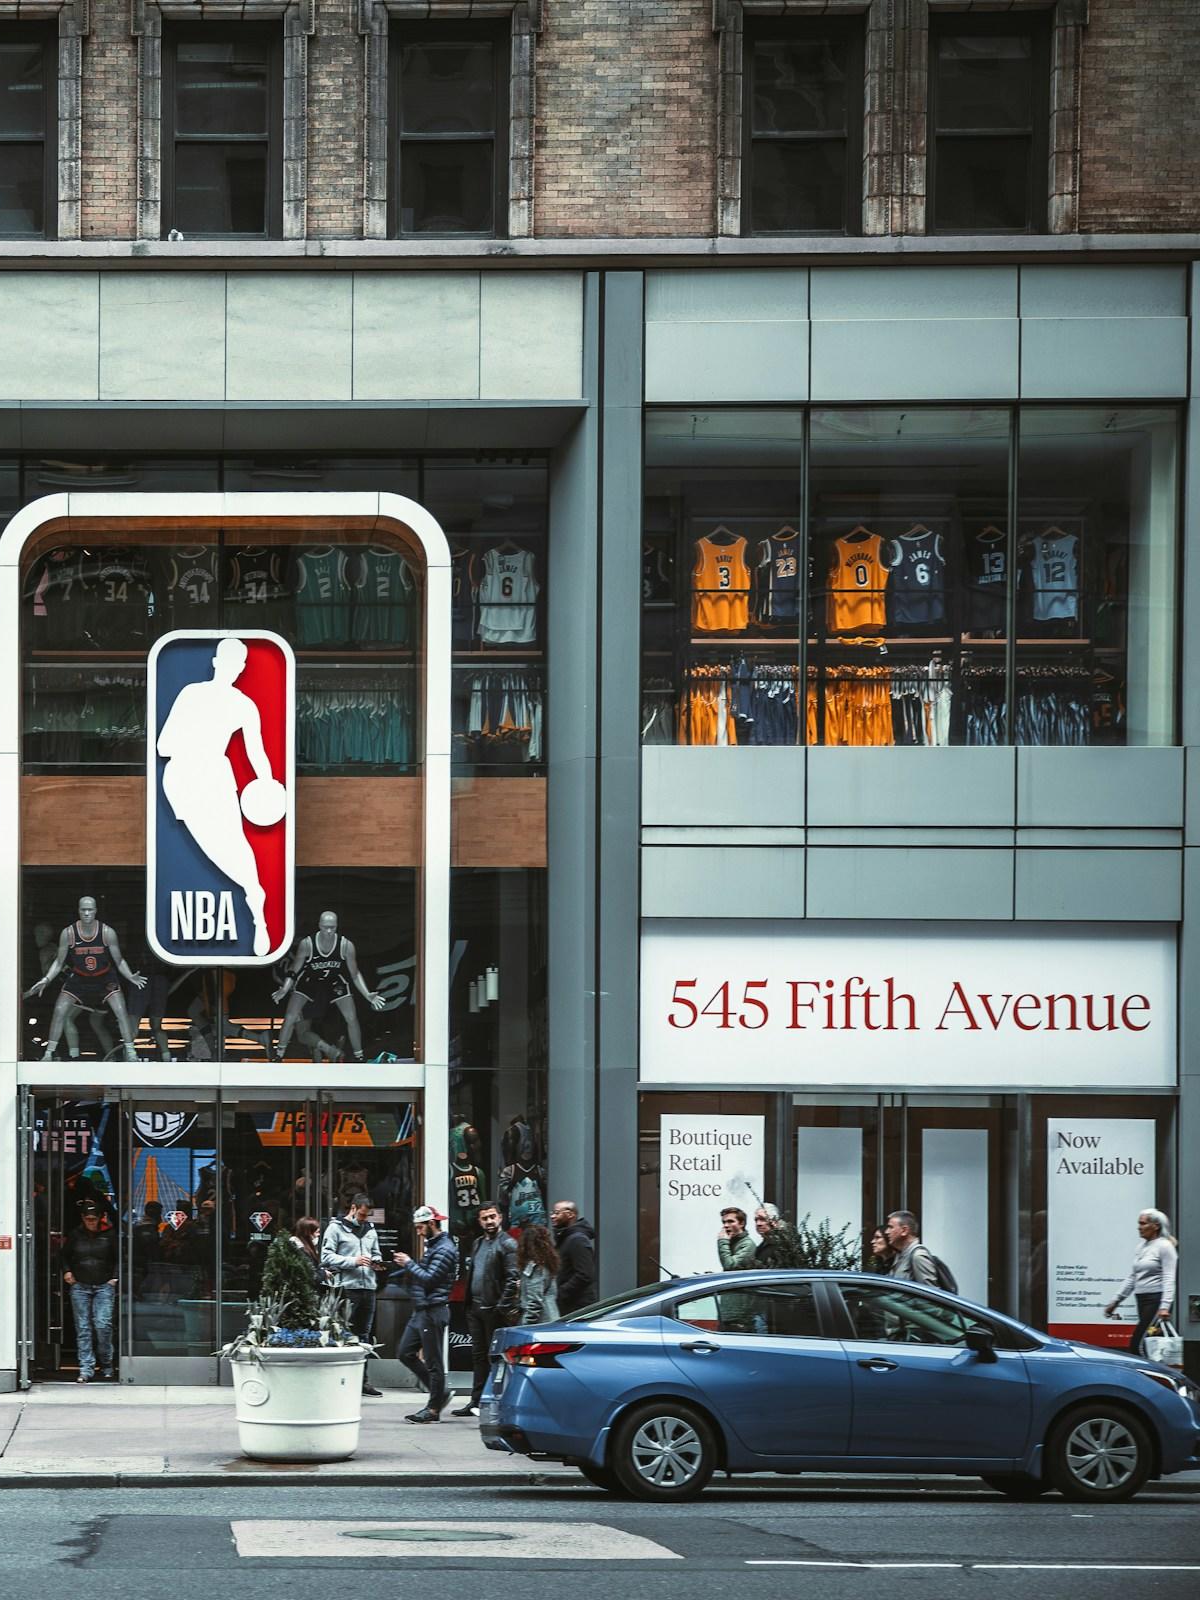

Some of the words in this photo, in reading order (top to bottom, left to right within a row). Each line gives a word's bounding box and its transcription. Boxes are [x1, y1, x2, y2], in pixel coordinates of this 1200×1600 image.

[776, 556, 797, 578] 23
[909, 551, 932, 562] JAMES
[982, 552, 1005, 574] 13
[719, 566, 730, 588] 3
[855, 564, 868, 587] 0
[915, 563, 929, 584] 6
[1043, 562, 1065, 583] 12
[104, 581, 128, 602] 34
[187, 582, 210, 604] 34
[245, 581, 267, 604] 34
[318, 577, 331, 599] 2
[376, 576, 390, 597] 2
[502, 577, 513, 596] 6
[171, 891, 238, 940] NBA
[85, 956, 97, 971] 9
[322, 970, 330, 978] 7
[668, 977, 769, 1029] 545
[786, 976, 921, 1031] Fifth
[935, 981, 1152, 1031] Avenue
[669, 1128, 752, 1150] Boutique
[1056, 1132, 1101, 1149] Now
[668, 1154, 722, 1171] Retail
[1056, 1157, 1145, 1175] Available
[456, 1189, 481, 1207] 33
[668, 1180, 722, 1201] Space
[528, 1202, 545, 1213] 32
